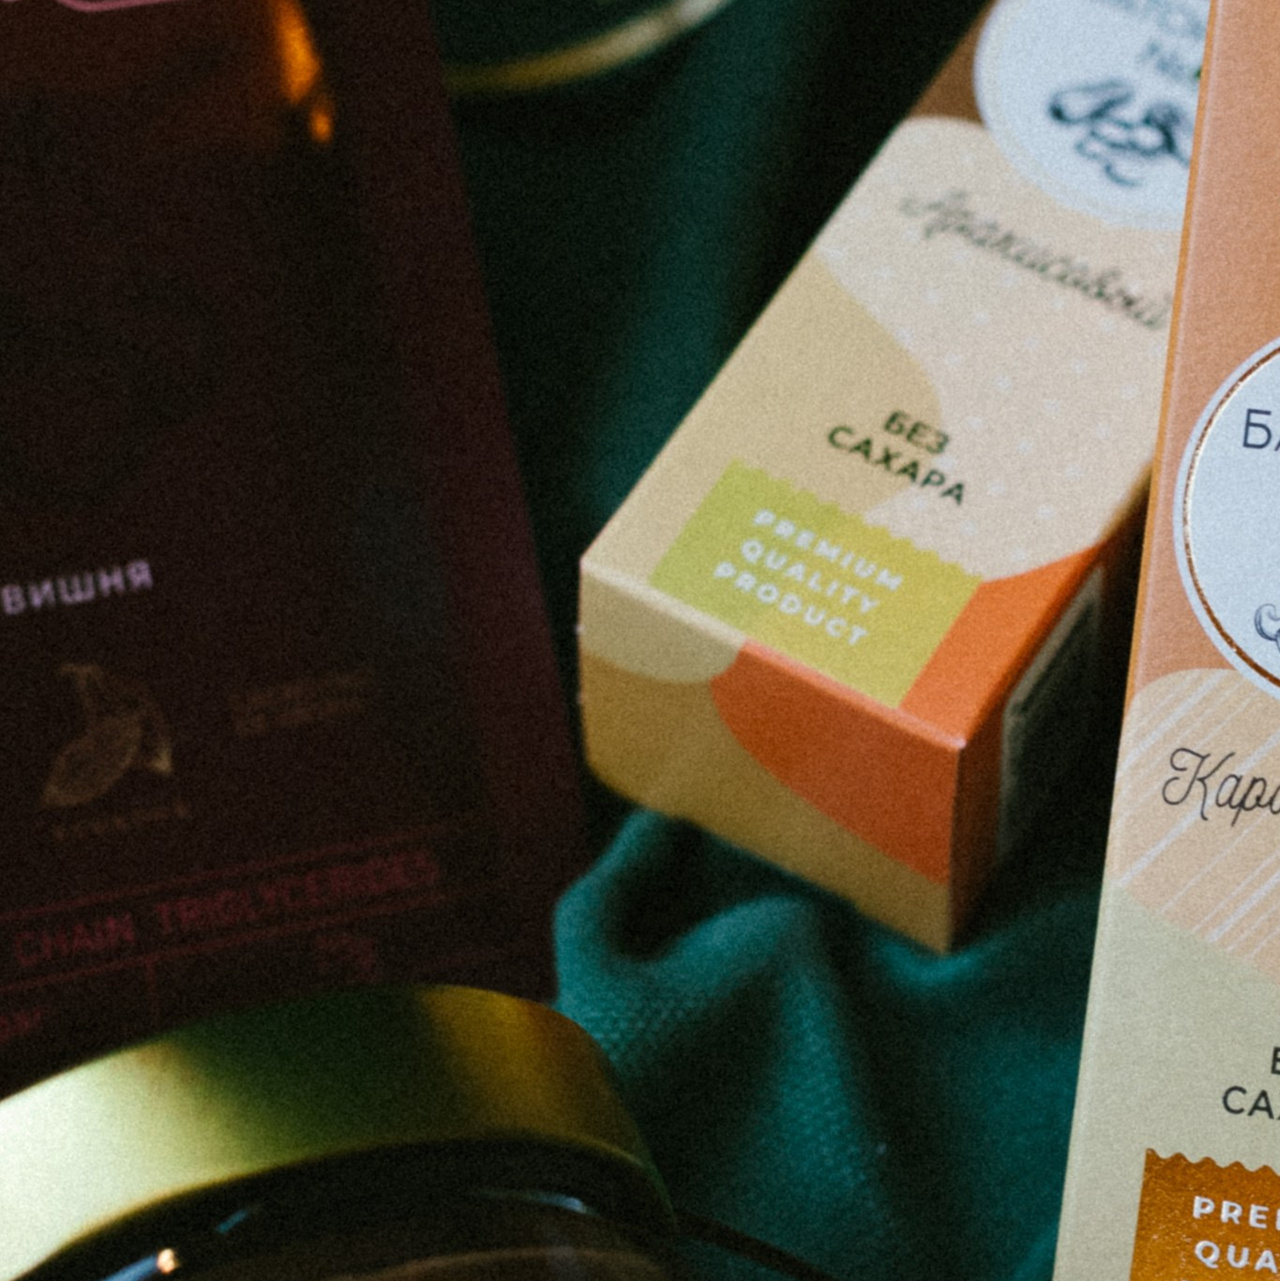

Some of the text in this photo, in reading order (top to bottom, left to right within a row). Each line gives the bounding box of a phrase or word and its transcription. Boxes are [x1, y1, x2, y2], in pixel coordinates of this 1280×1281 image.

[827, 425, 965, 507] САХАРА
[883, 409, 951, 455] БЕЗ
[741, 538, 880, 614] QUALITY
[753, 509, 902, 593] PREMIUM
[713, 561, 870, 646] PRODUCT
